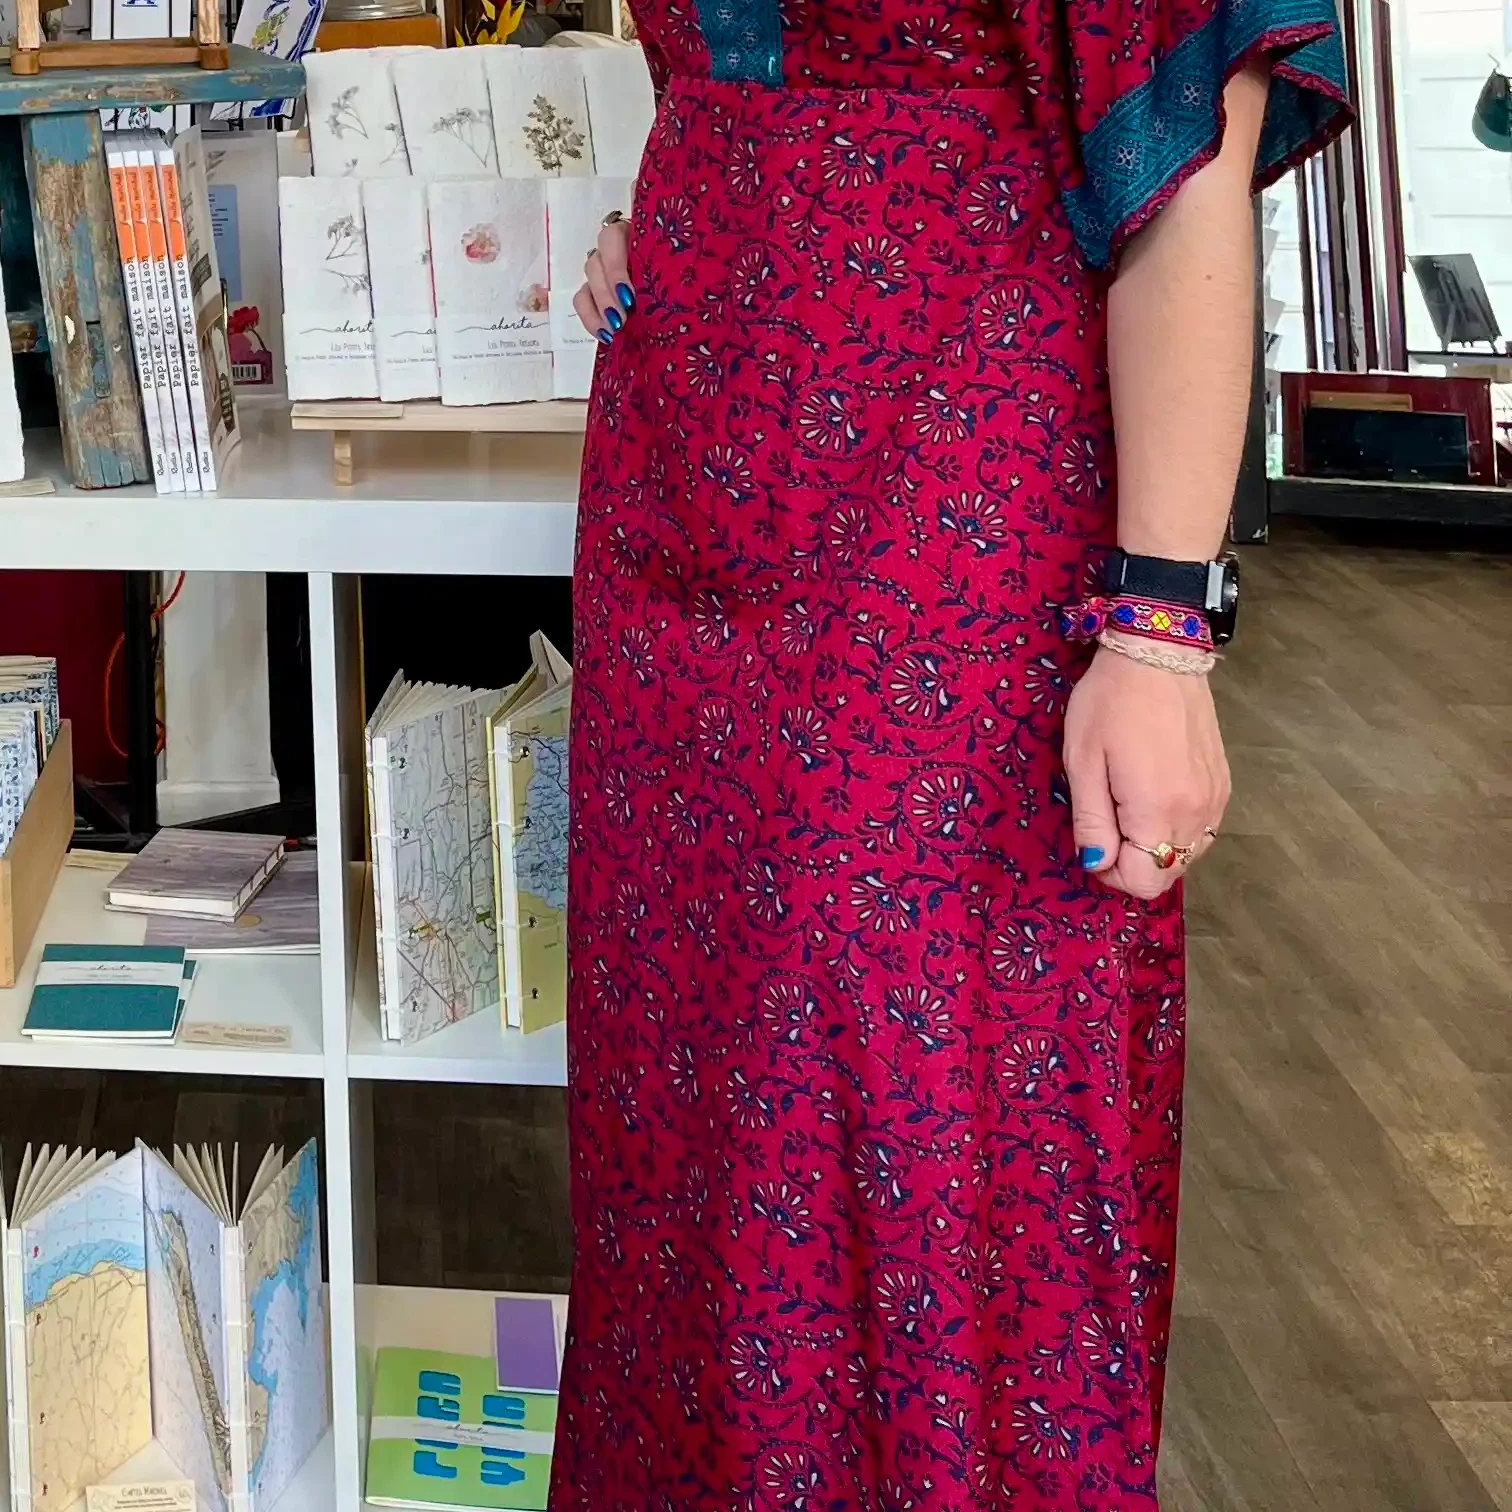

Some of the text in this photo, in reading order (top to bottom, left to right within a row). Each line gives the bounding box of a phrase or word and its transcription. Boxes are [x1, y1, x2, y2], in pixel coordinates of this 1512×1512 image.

[126, 255, 153, 389] Papier fait maison
[141, 255, 166, 388] Papier fait maison
[157, 255, 182, 388] Papier fait maison
[176, 254, 200, 387] Papier fait maison
